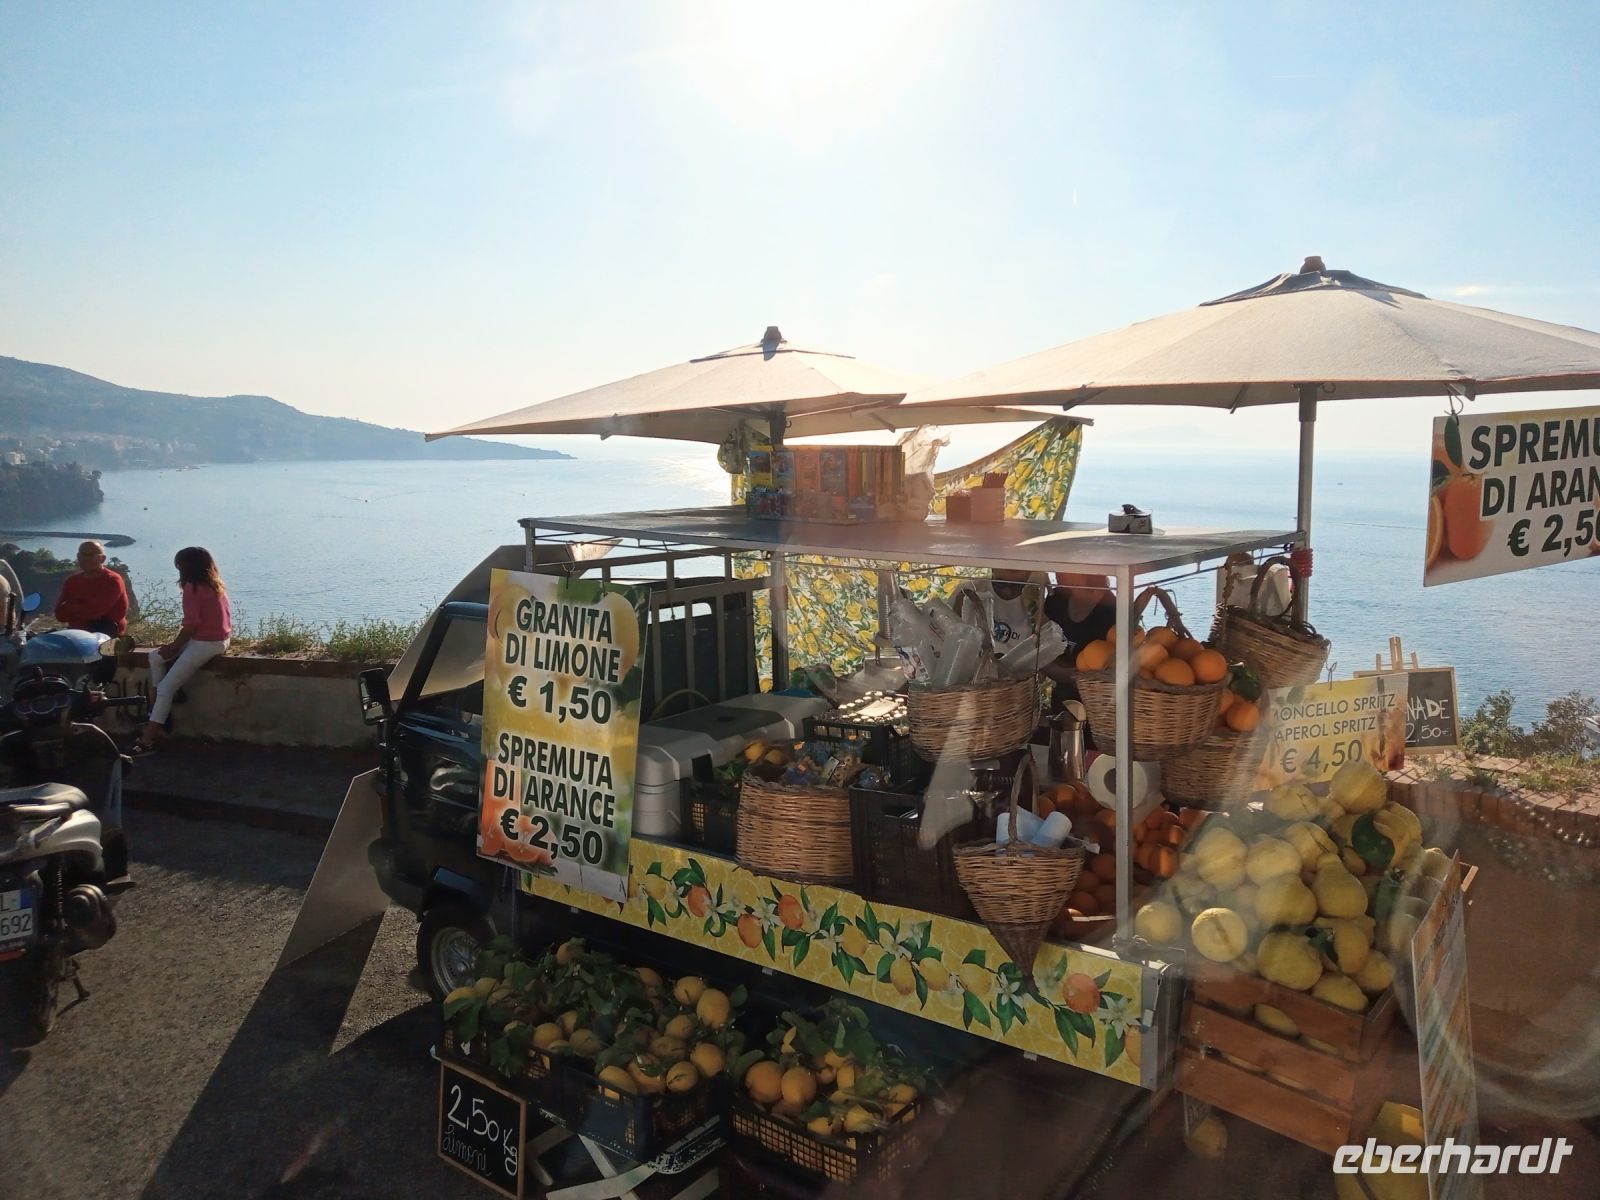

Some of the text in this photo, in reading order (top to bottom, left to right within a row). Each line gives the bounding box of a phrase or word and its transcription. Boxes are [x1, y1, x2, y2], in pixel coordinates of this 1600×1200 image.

[1482, 475, 1517, 517] DI
[1507, 509, 1600, 557] € 2,5
[516, 598, 612, 644] GRANITA
[505, 632, 620, 683] DI LIMONE
[508, 675, 611, 724] € 1,50
[1353, 693, 1396, 713] SPRITZ
[1406, 695, 1450, 722] NADE
[1276, 716, 1376, 742] APEROL SPRITZ
[497, 732, 612, 790] SPREMUTA
[1280, 739, 1363, 774] € 4,50
[493, 766, 615, 829] DI ARANCE
[500, 808, 603, 865] € 2,50
[447, 1084, 500, 1142] 2,50
